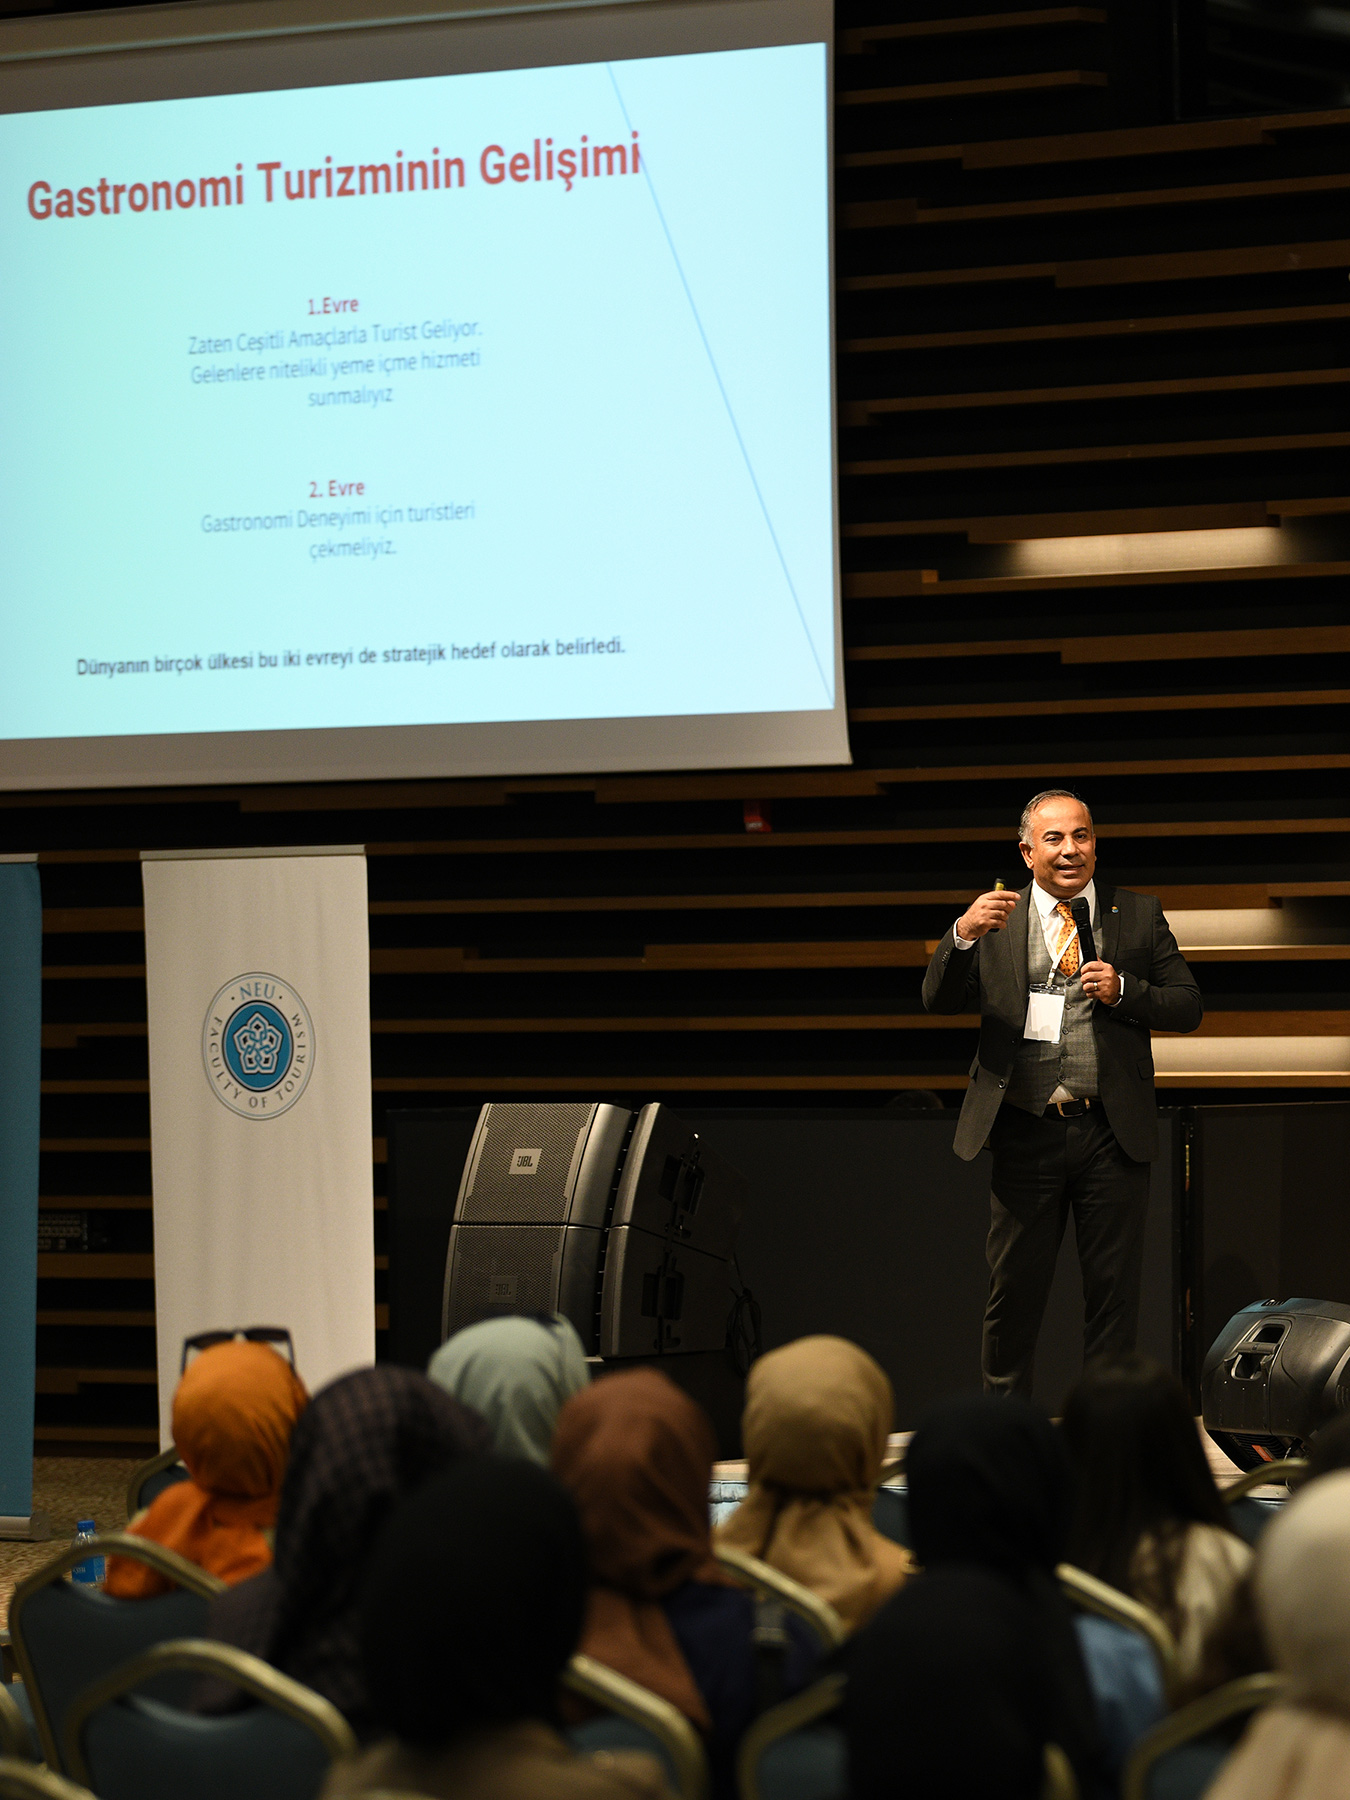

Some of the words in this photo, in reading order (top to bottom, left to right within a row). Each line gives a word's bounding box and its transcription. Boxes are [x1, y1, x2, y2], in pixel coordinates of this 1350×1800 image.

[28, 163, 243, 220] Gastronomi
[257, 147, 465, 202] Turizminin
[480, 131, 638, 192] Gelişimi
[188, 336, 232, 355] Zaten
[289, 327, 367, 351] Amaçlarla
[372, 322, 417, 343] Turist
[421, 318, 483, 343] Geliyor.
[191, 364, 266, 385] Gelenlere
[269, 357, 327, 380] nitelikli
[330, 360, 374, 380] yeme
[378, 353, 417, 377] içme
[421, 347, 480, 370] hizmeti
[309, 481, 323, 498] 2.
[329, 480, 365, 496] Evre
[201, 510, 293, 533] Gastronomi
[297, 506, 371, 531] Deneyimi
[375, 504, 403, 528] için
[408, 501, 476, 522] turistleri
[77, 658, 149, 679] Dünyanın
[155, 654, 202, 676] birçok
[208, 652, 253, 670] ülkesi
[258, 651, 278, 668] bu
[283, 649, 300, 667] iki
[306, 648, 353, 669] evreyi
[358, 647, 377, 664] de
[383, 643, 446, 665] stratejik
[451, 641, 497, 660] hedef
[501, 640, 550, 658] olarak
[555, 636, 626, 656] belirledi.
[239, 981, 276, 1000] NEU
[209, 1016, 242, 1100] FACULTY
[249, 1096, 267, 1108] OF
[275, 1013, 306, 1101] TOURISM
[517, 1155, 533, 1167] JBL
